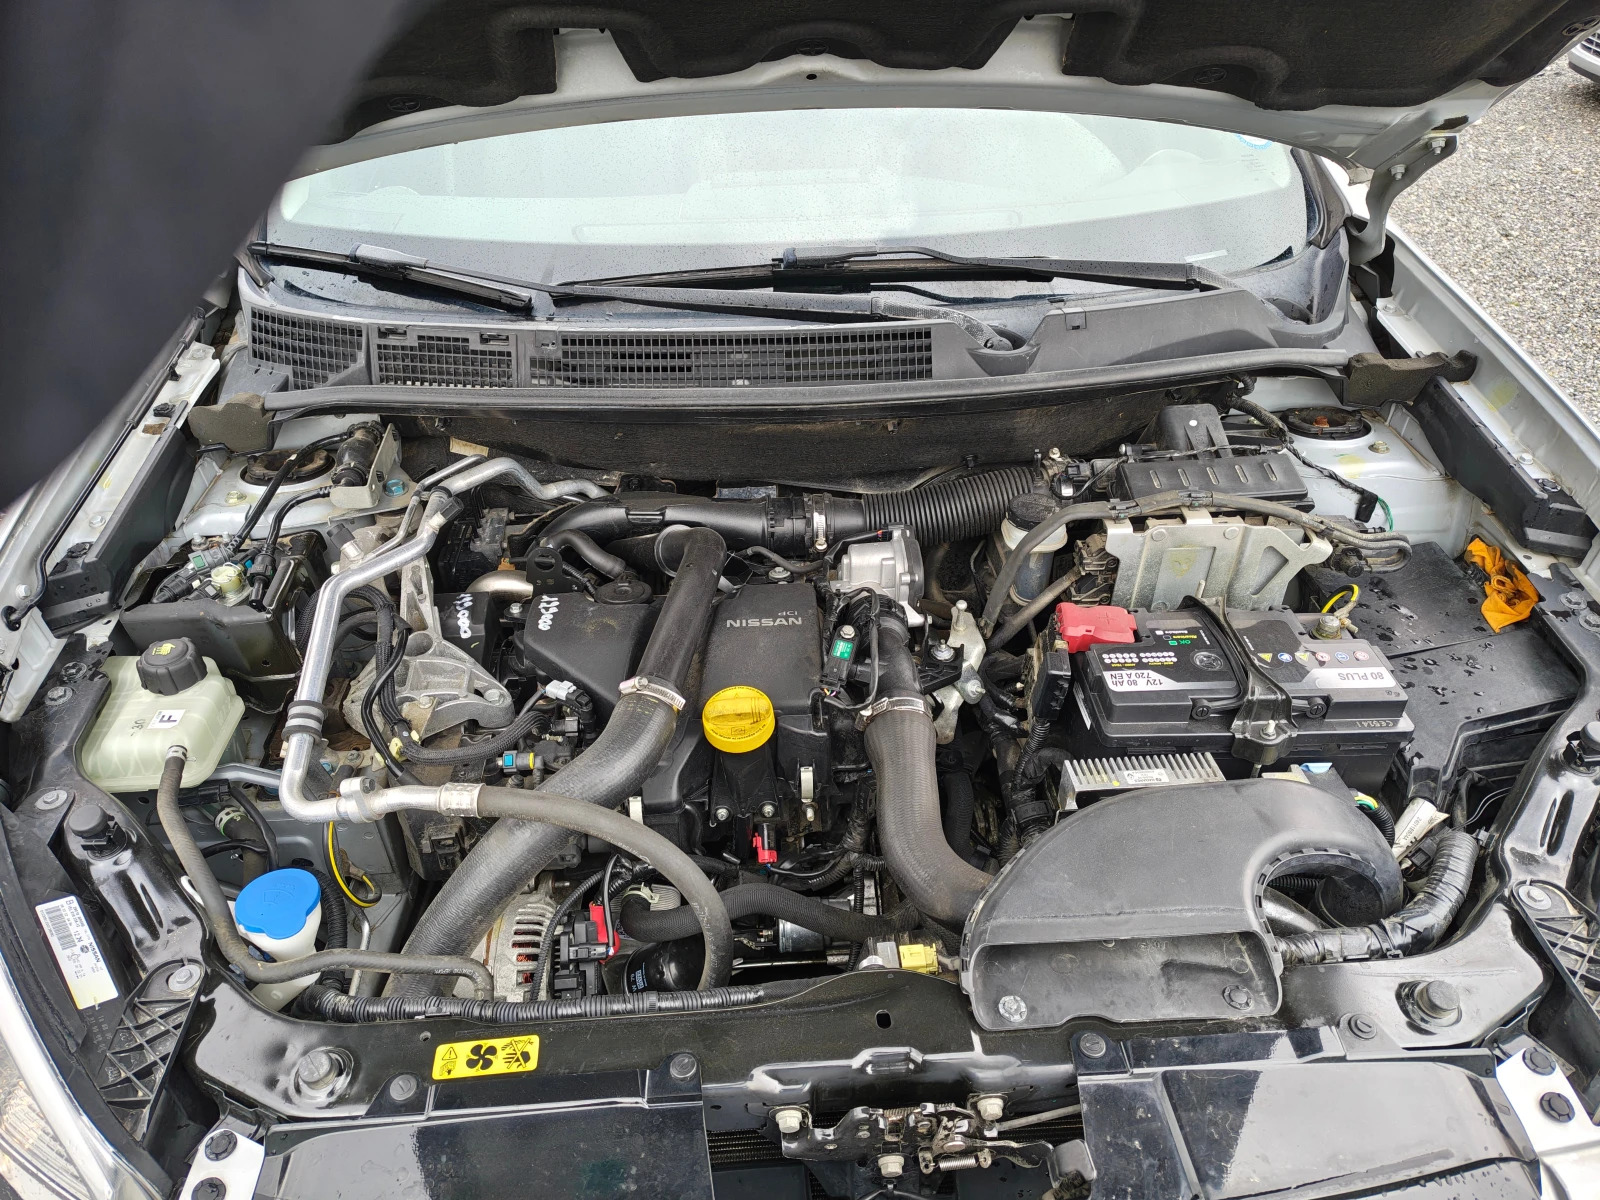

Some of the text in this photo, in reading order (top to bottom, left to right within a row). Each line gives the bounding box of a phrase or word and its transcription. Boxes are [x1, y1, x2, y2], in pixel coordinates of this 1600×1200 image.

[726, 617, 803, 628] NISSAN
[1134, 671, 1152, 679] 720
[1337, 671, 1385, 681] 80 PLUS
[1126, 679, 1138, 687] 80
[1145, 679, 1164, 687] 12V
[158, 714, 178, 723] F
[88, 941, 102, 963] NISSAN
